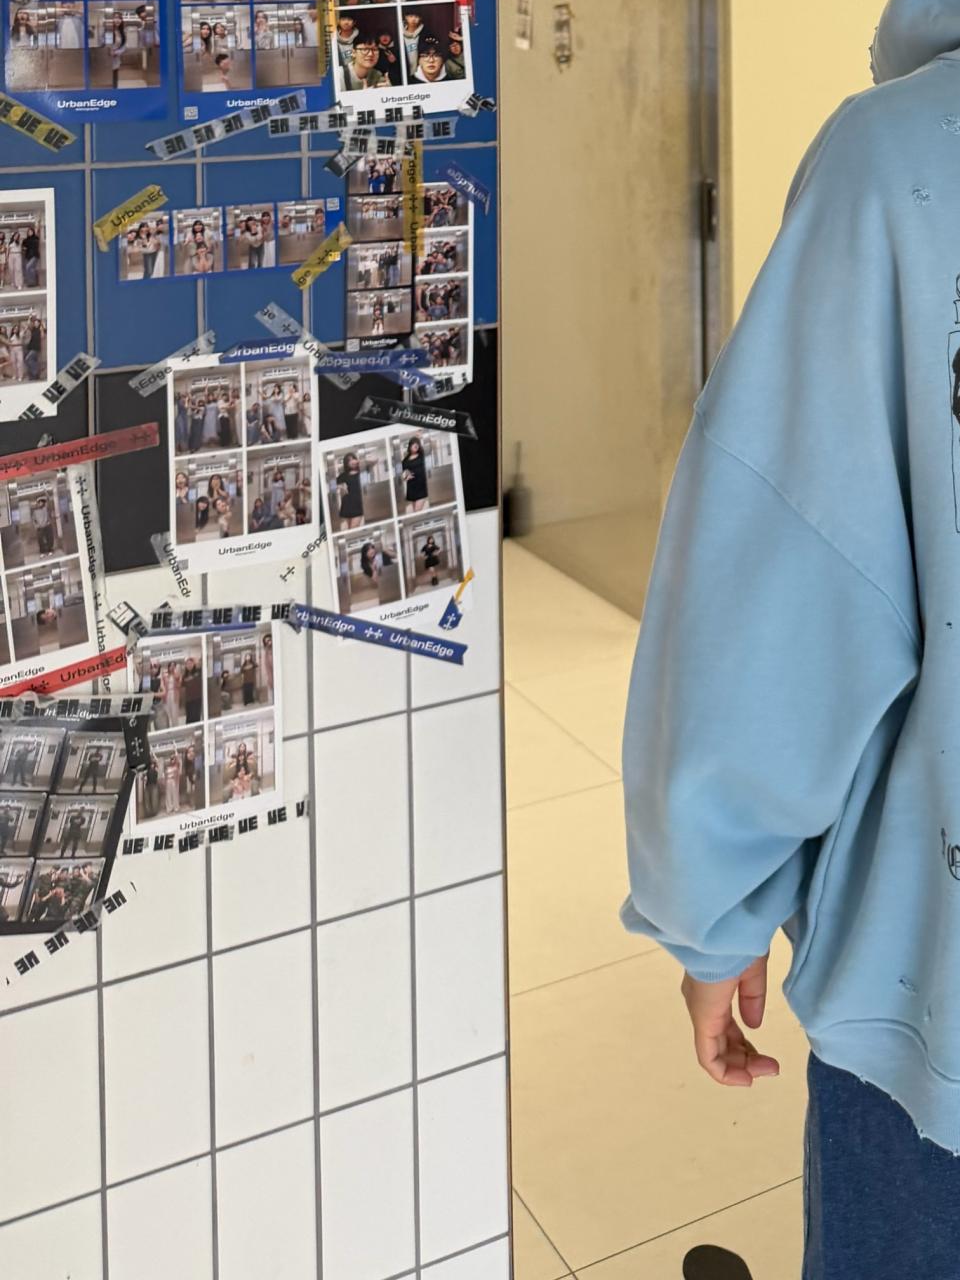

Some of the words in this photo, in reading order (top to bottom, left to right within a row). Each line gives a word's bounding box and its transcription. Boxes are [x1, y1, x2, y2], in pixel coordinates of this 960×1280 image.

[57, 99, 117, 109] UrbanEdge
[381, 93, 431, 103] UrbanEdge
[389, 407, 456, 427] UrbanEdge
[34, 439, 117, 465] UrbanEdge
[81, 505, 97, 579] UrbanEdge
[218, 541, 272, 555] UrbanEdge
[380, 603, 429, 620] UrbanEdge
[390, 633, 453, 656] UrbanEdge
[180, 812, 235, 830] UrbanEdge
